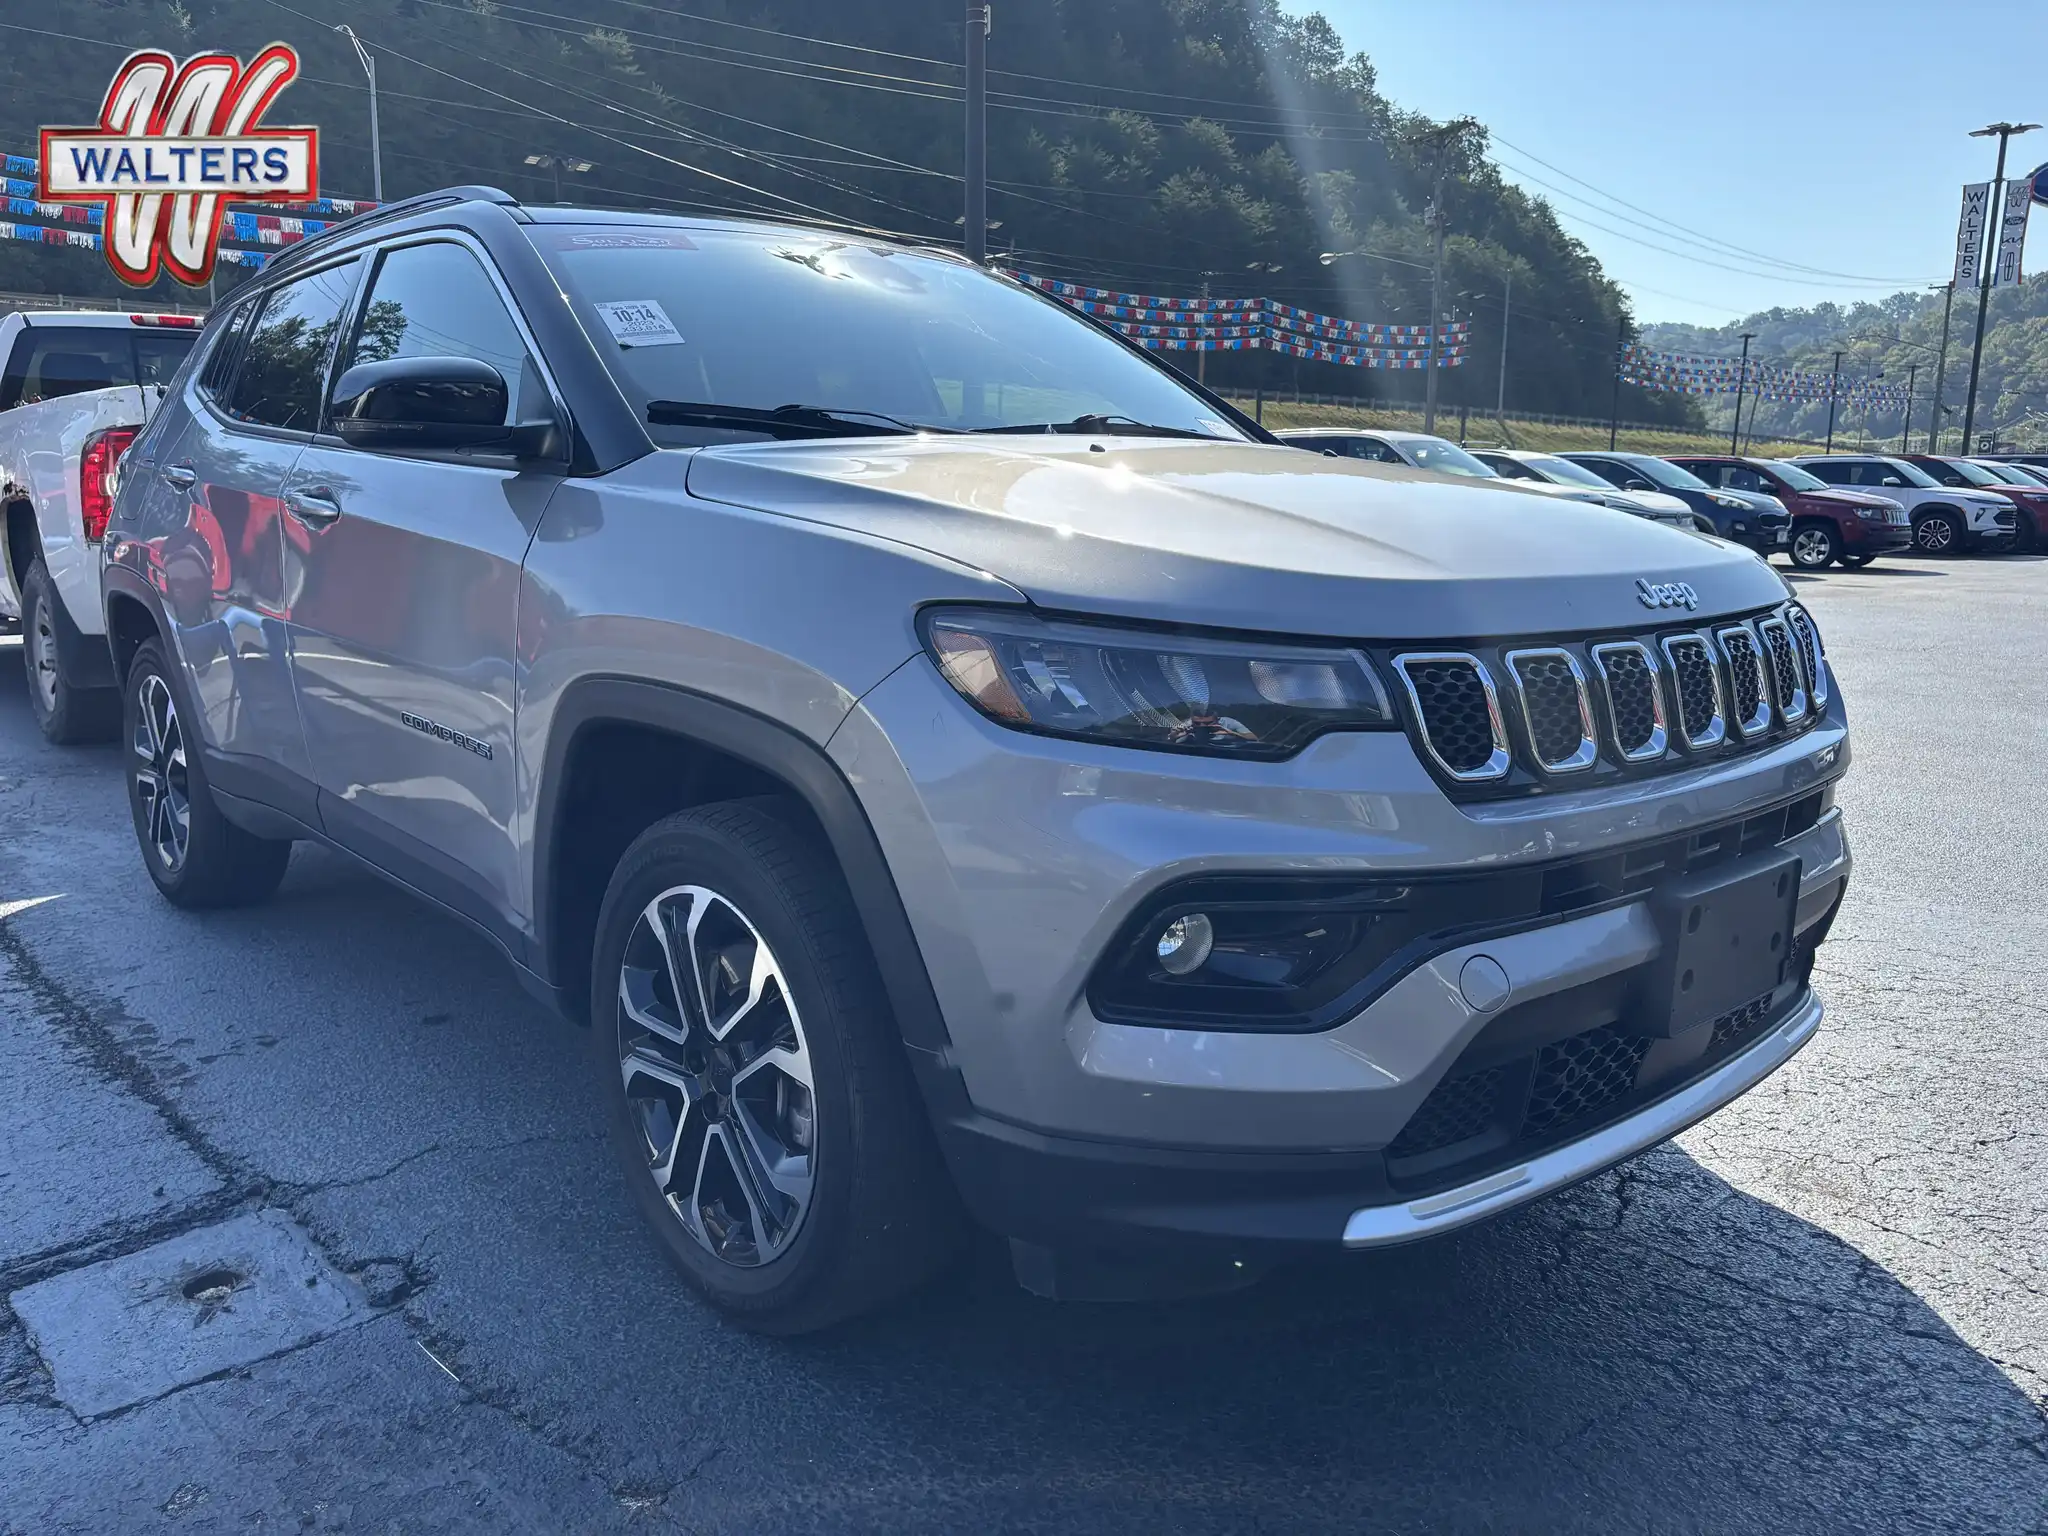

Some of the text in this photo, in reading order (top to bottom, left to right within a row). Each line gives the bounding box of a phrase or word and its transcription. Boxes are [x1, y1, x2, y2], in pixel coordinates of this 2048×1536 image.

[1961, 191, 1985, 279] WALTERS
[613, 308, 655, 322] 10:14
[1634, 578, 1699, 612] Jeep
[401, 710, 493, 761] COMPASS
